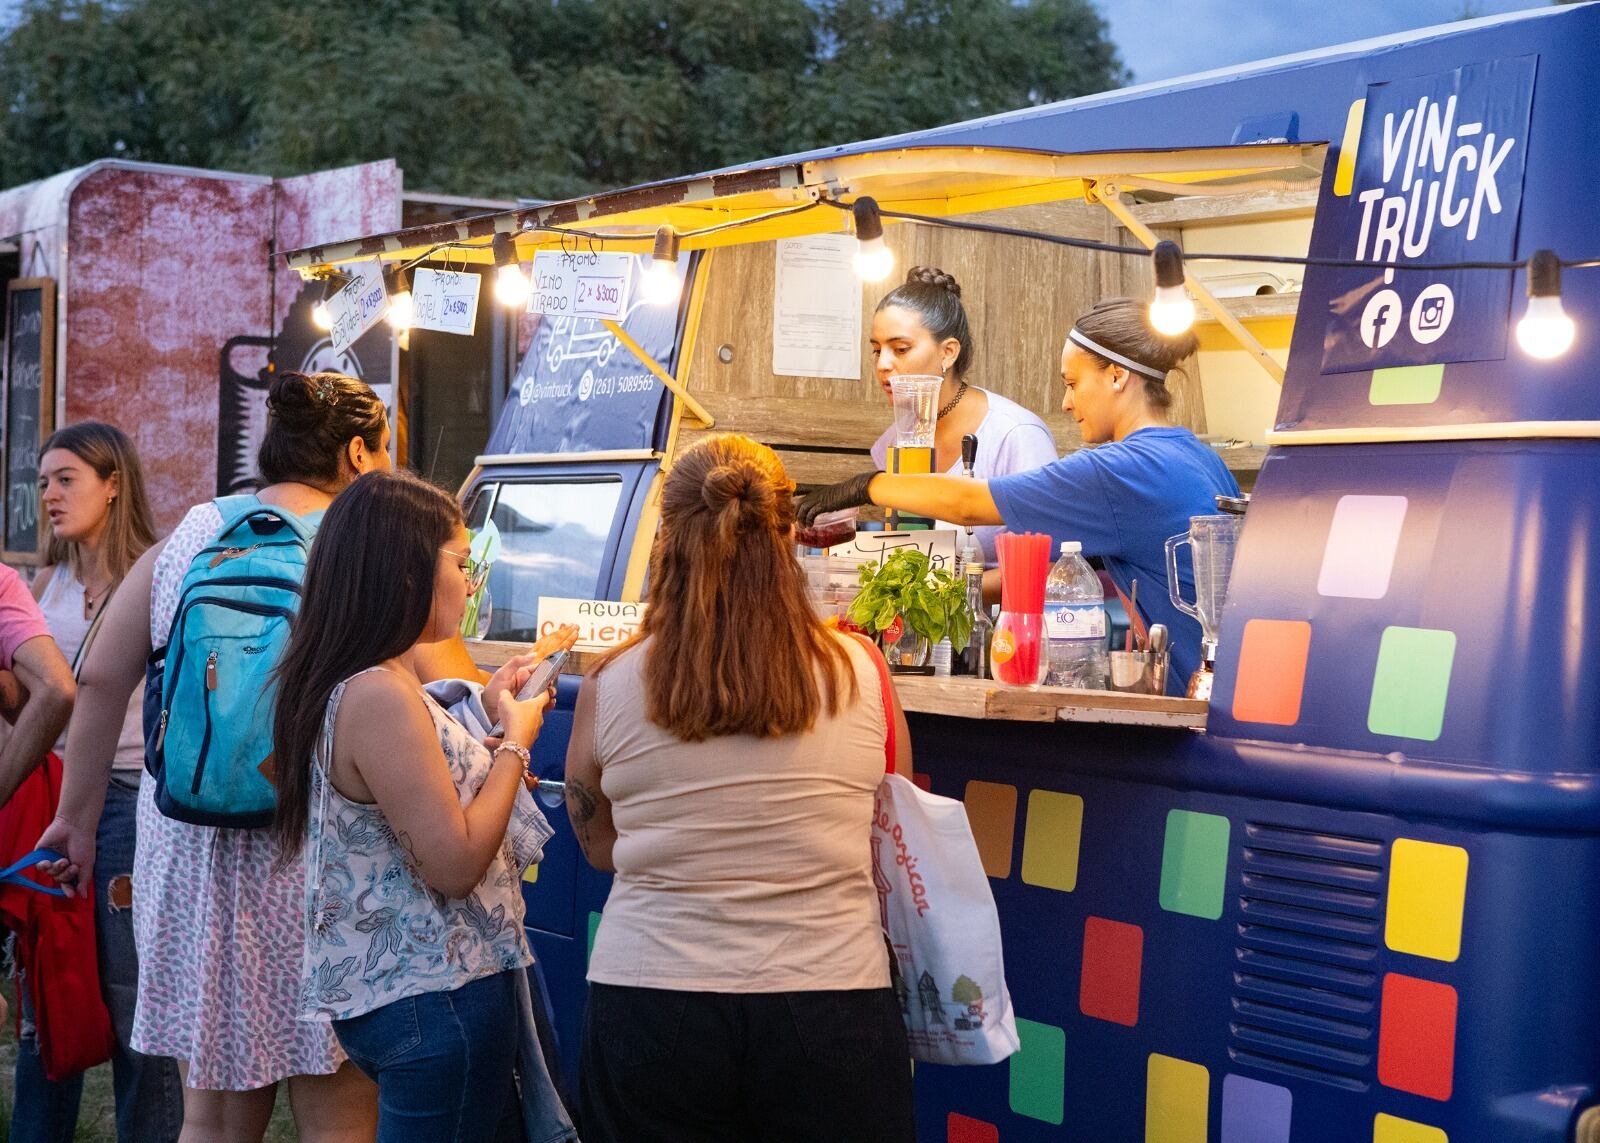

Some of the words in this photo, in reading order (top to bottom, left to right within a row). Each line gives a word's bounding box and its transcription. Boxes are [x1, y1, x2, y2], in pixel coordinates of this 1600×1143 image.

[1355, 132, 1515, 284] TRUCK
[535, 270, 562, 290] VINO
[578, 282, 585, 303] 2
[532, 380, 573, 403] @vintruck
[593, 376, 615, 399] (261)
[617, 374, 655, 393] 5089565
